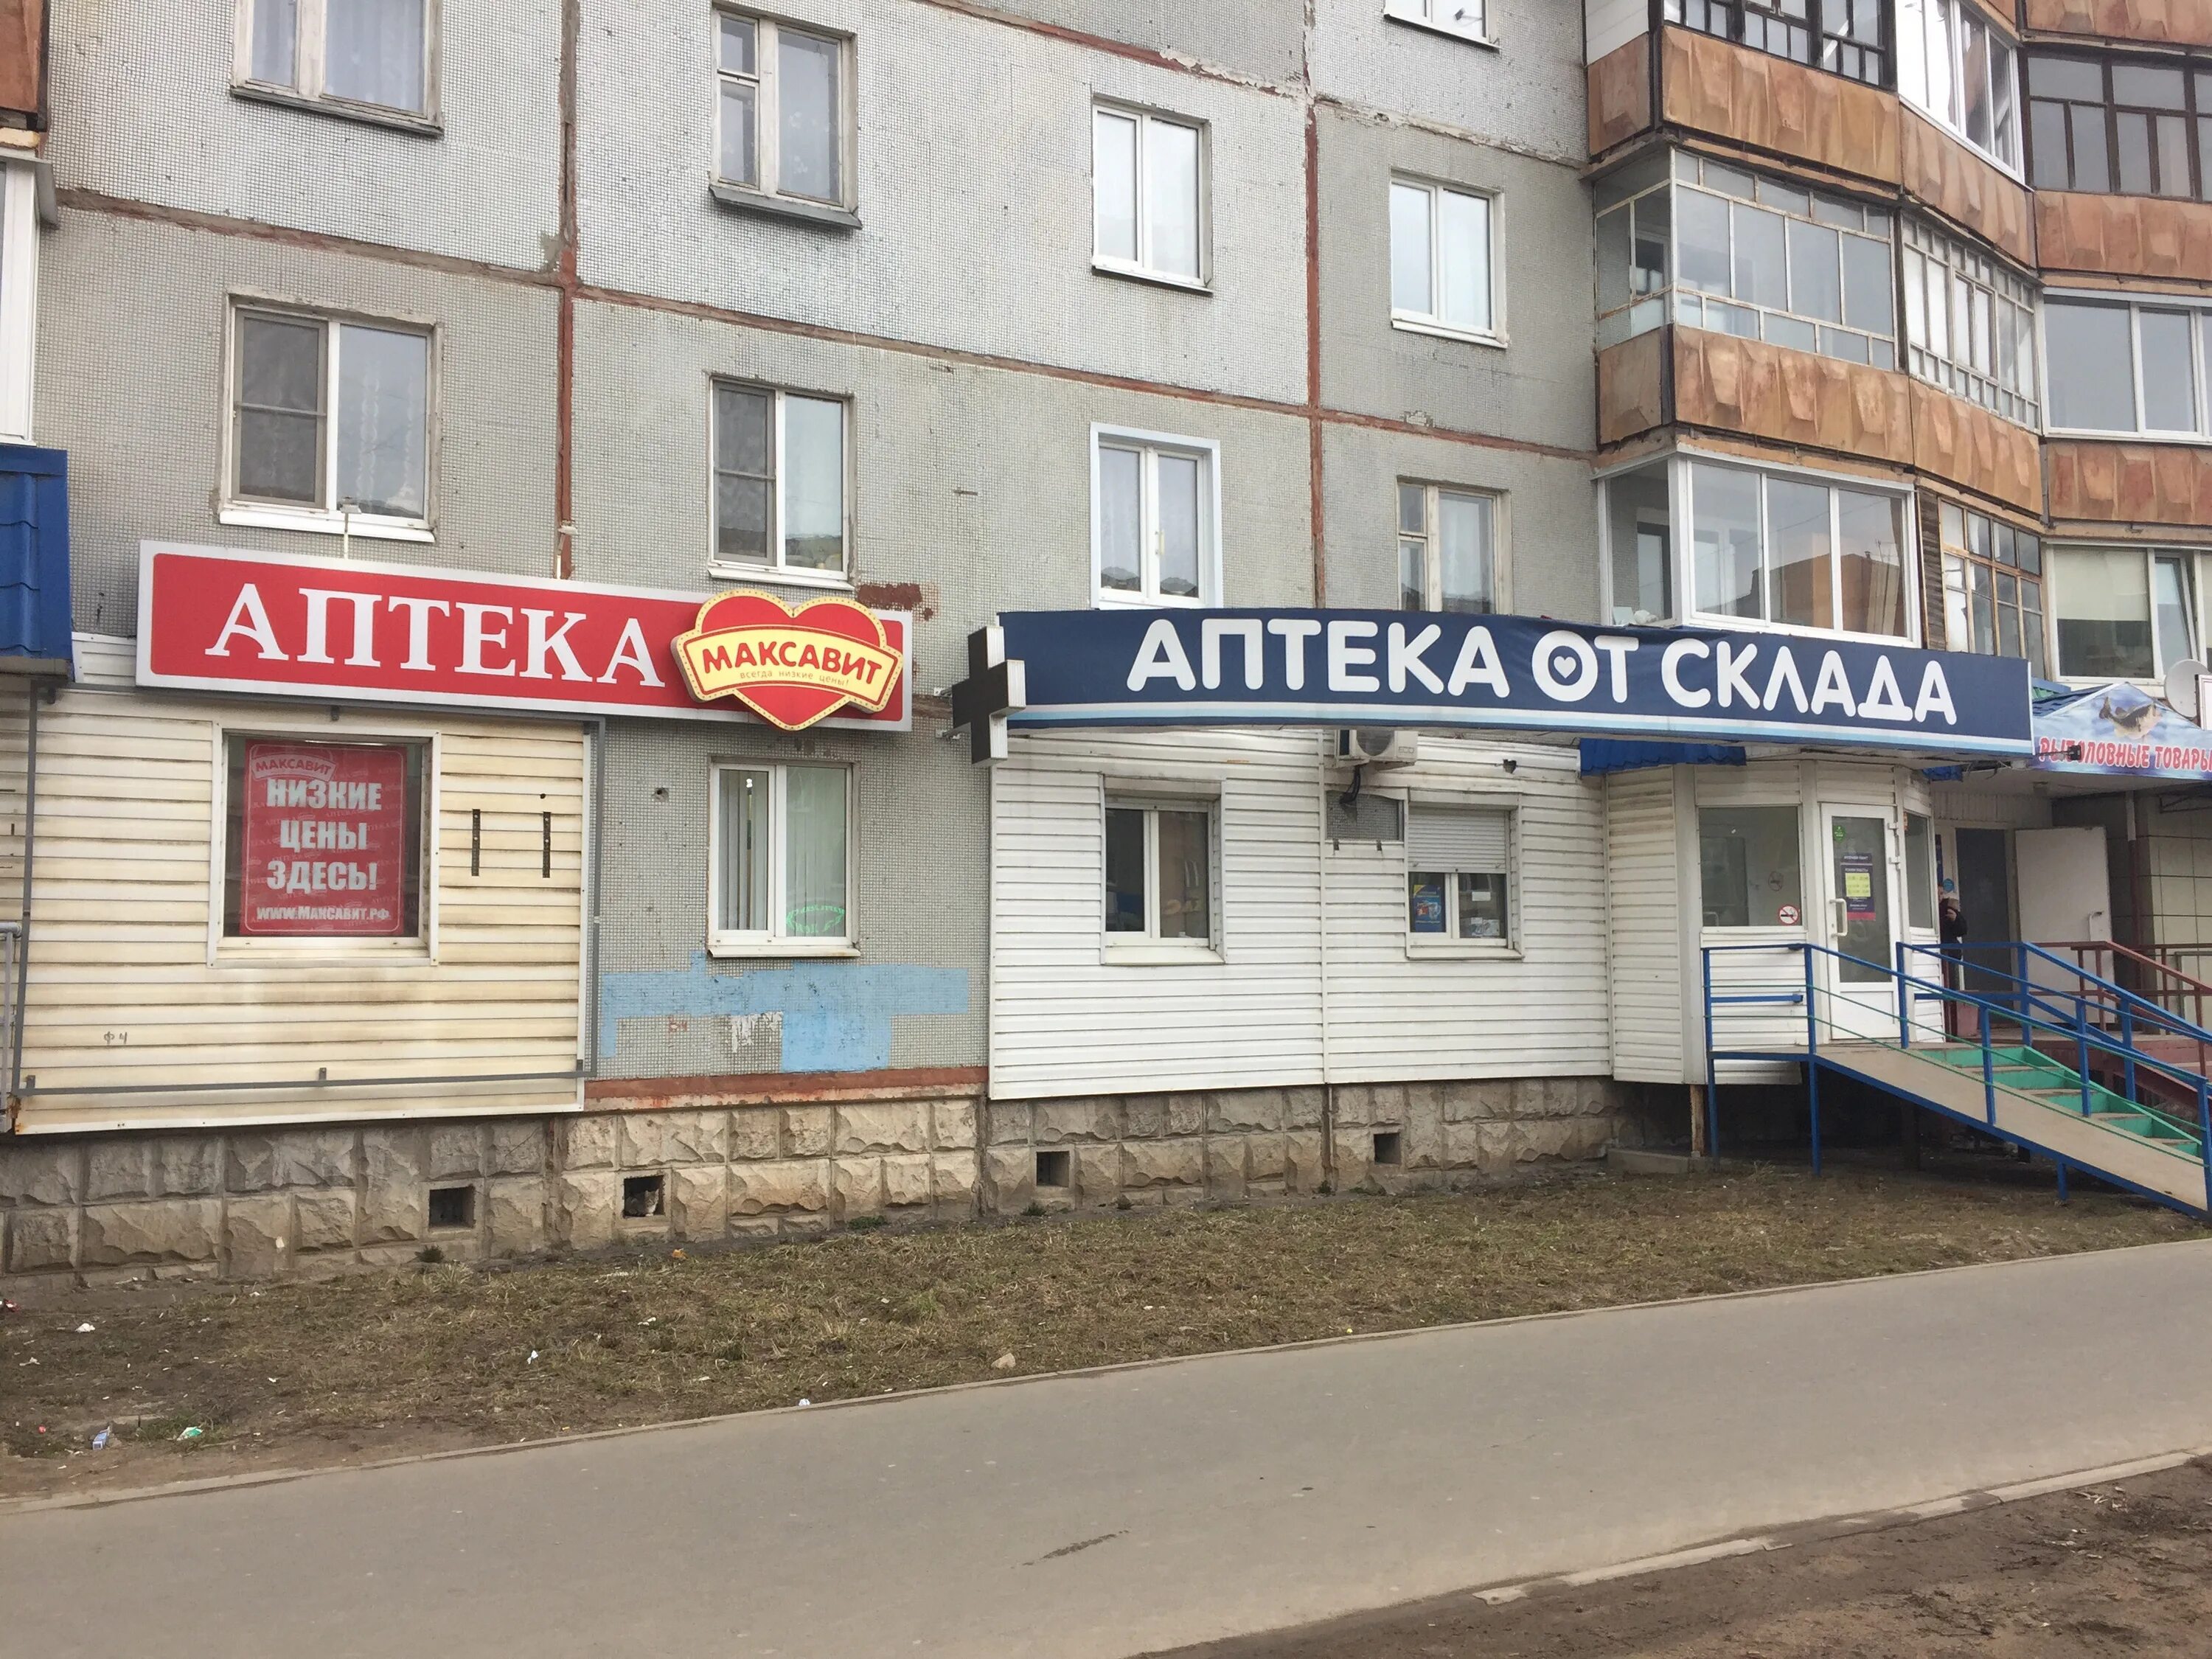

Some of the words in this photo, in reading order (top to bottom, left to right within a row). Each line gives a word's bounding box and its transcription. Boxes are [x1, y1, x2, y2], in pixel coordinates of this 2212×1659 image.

[204, 582, 666, 687] АПТЕКА
[702, 641, 883, 684] МАКСАВИТ
[740, 669, 773, 679] всегда
[779, 670, 814, 680] низкие
[1126, 618, 1511, 698] АПТЕКА
[1531, 630, 1640, 703] ОТ
[1660, 637, 1958, 726] СКЛАДА
[255, 758, 332, 775] МАКСАВИТ
[2154, 745, 2212, 772] ТОВАРЫ
[266, 778, 382, 810] НИЗКИЕ
[279, 819, 367, 852] ЦЕНЫ
[266, 860, 378, 894] ЗДЕСЬ!
